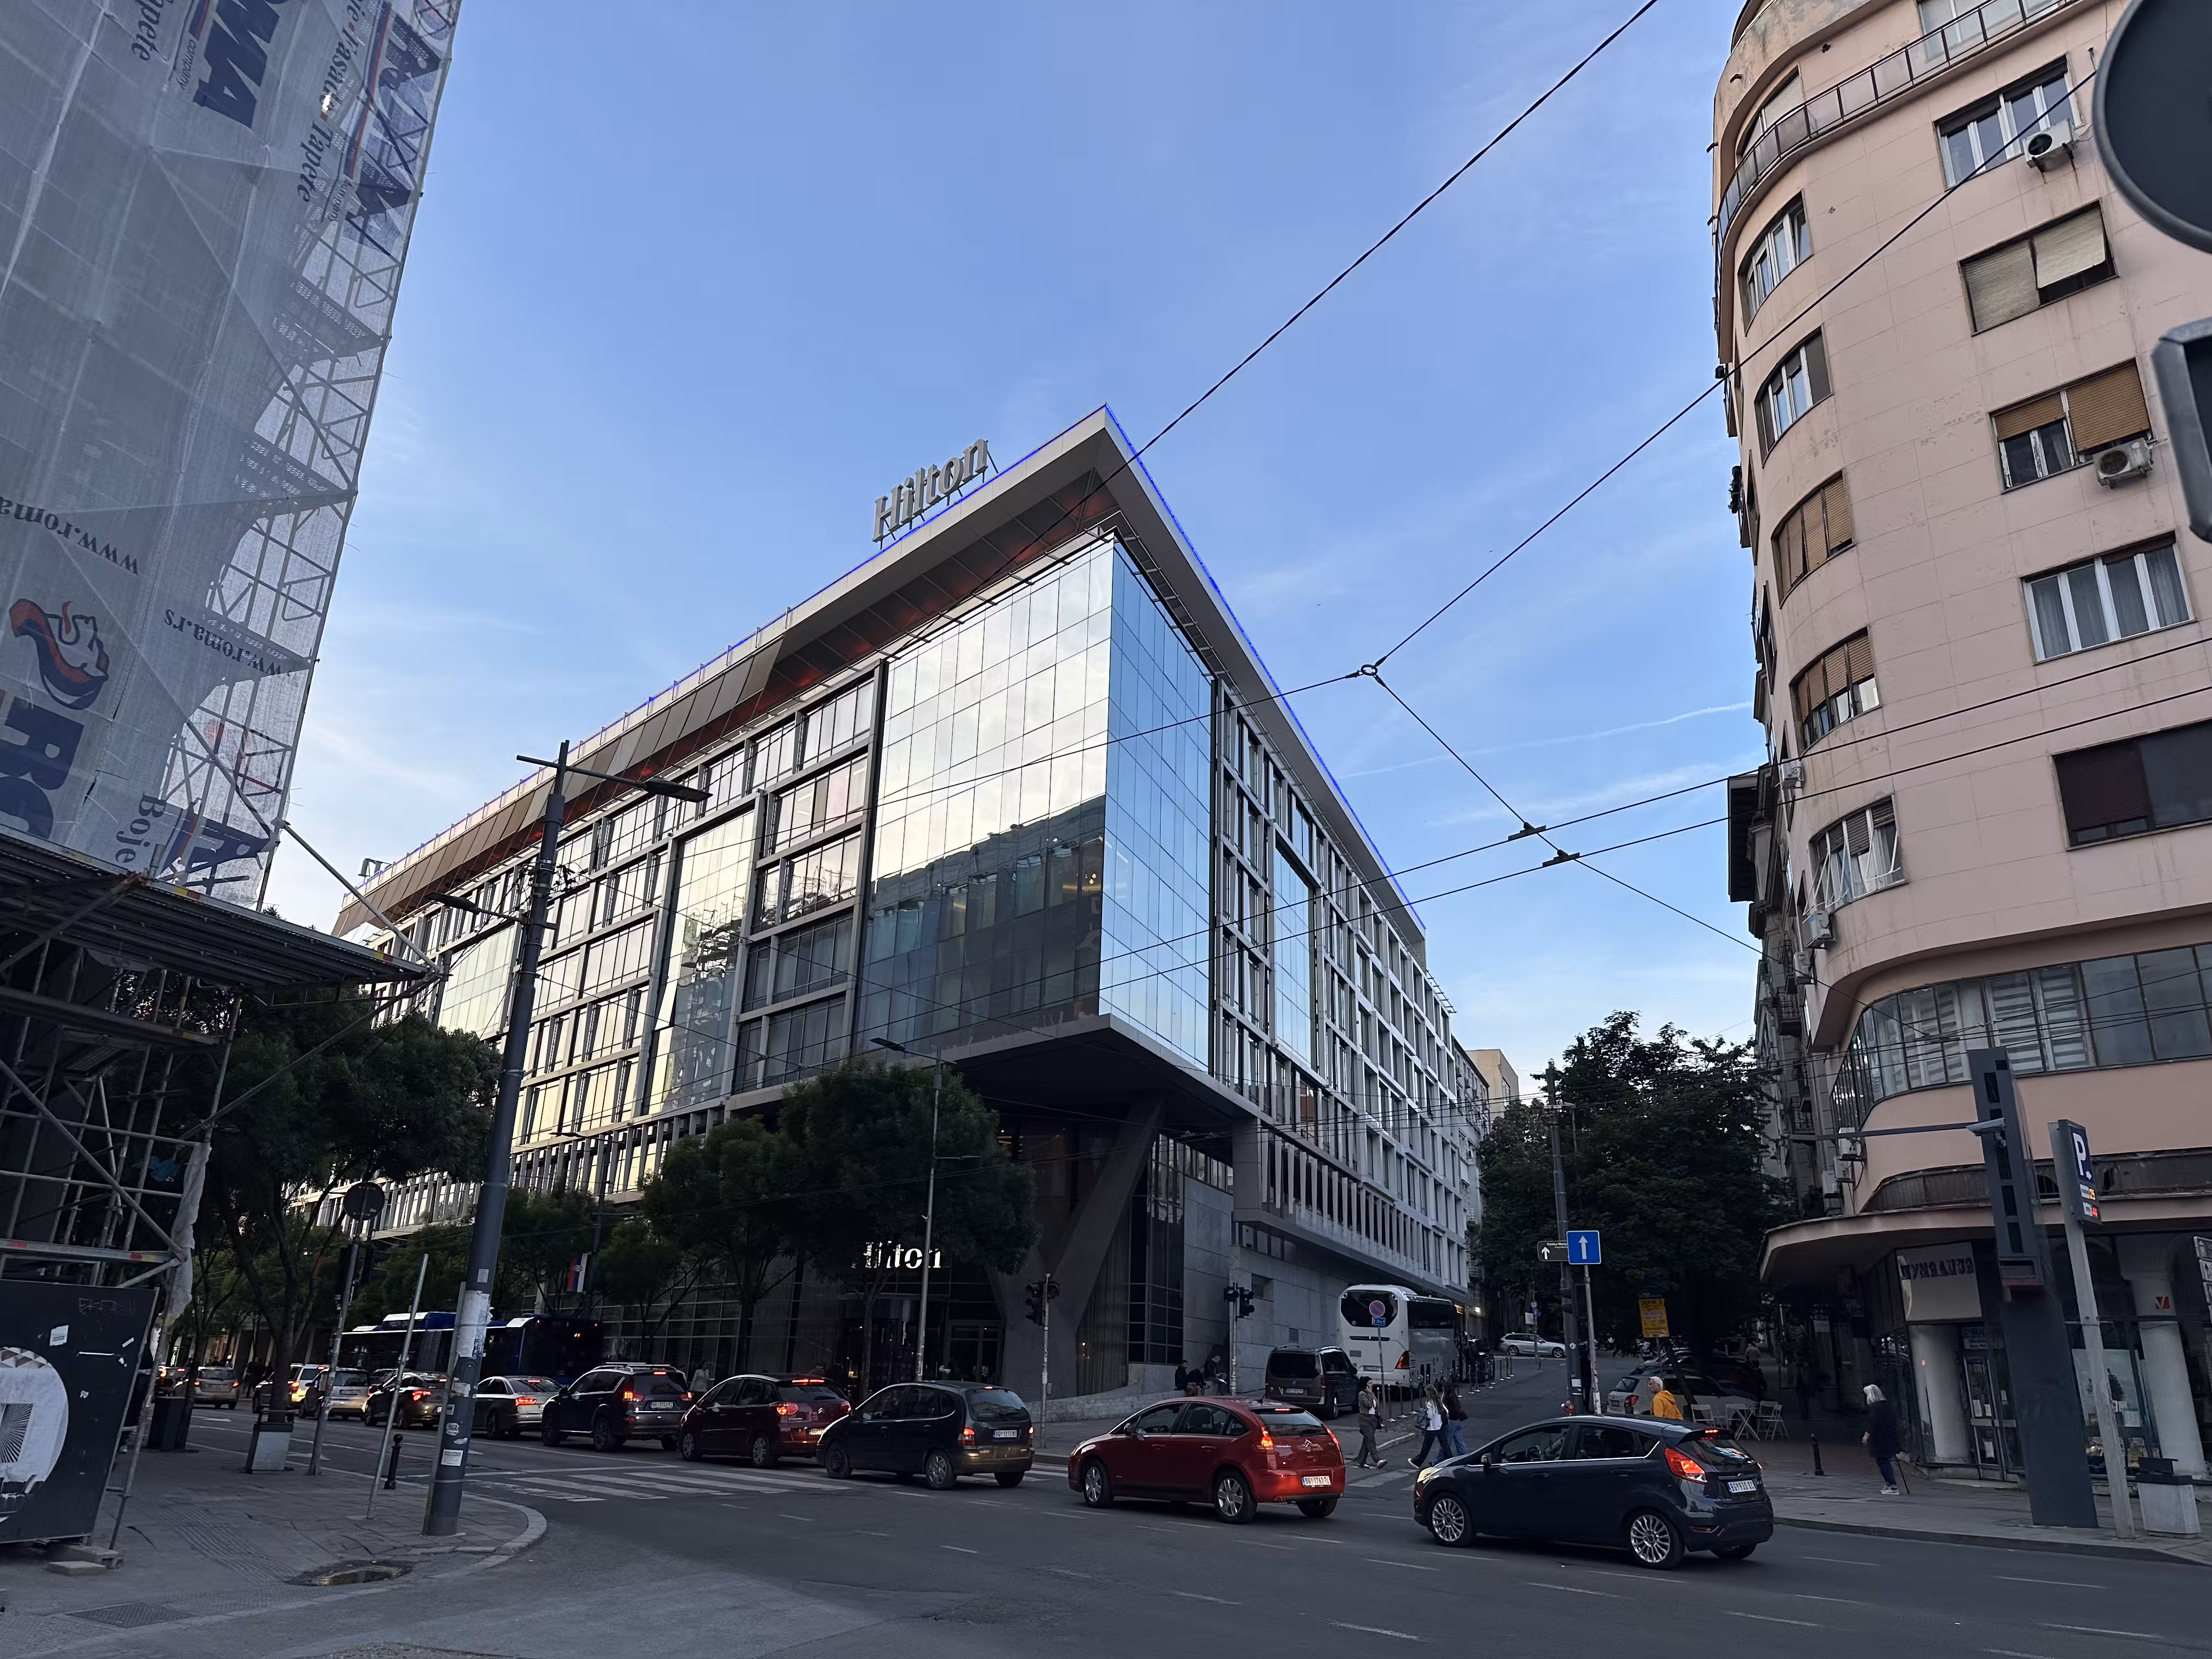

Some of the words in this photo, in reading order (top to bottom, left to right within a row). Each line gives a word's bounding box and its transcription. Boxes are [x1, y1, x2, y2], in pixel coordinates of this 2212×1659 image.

[131, 0, 173, 61] apete
[175, 39, 196, 91] company
[297, 120, 334, 203] Tapete
[328, 179, 353, 225] company
[872, 439, 988, 543] Hilton
[165, 610, 291, 676] ww.roma.rs
[115, 792, 167, 864] Boje
[2073, 1132, 2086, 1176] P
